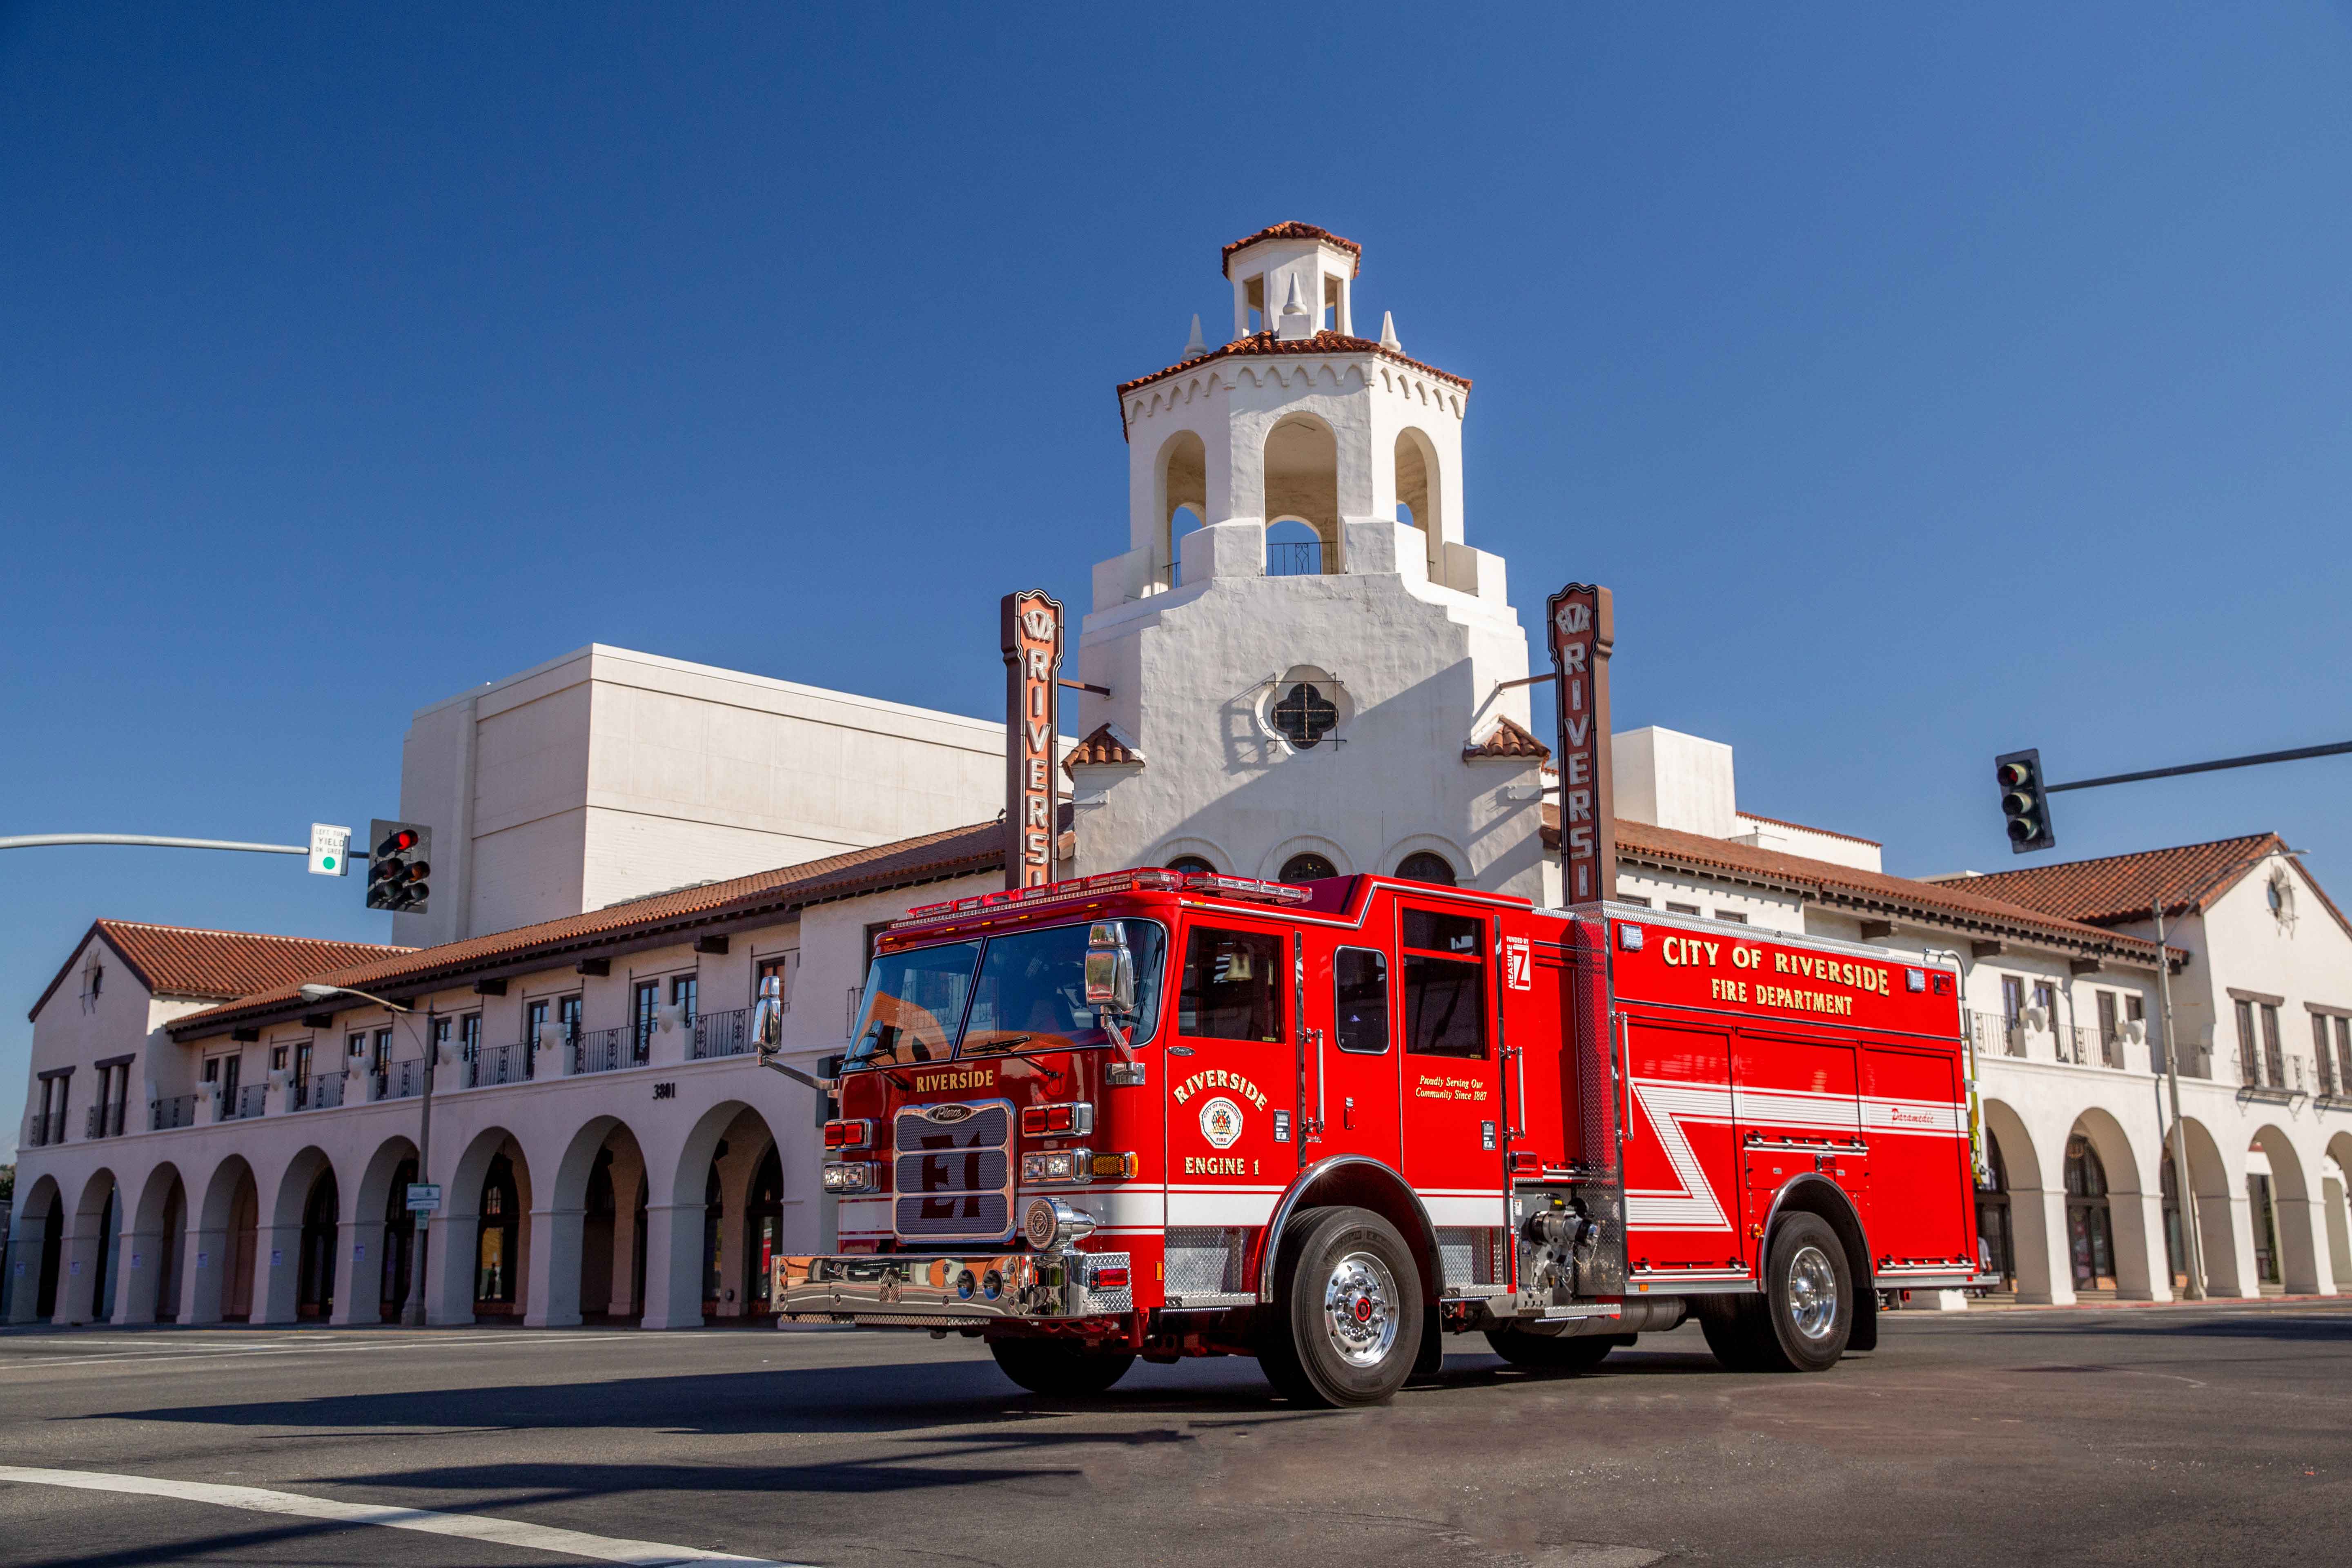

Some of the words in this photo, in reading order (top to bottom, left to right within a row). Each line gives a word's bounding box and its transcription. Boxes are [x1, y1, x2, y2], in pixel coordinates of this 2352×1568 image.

[1022, 609, 1056, 640] FOX
[1555, 603, 1591, 634] FOX
[318, 837, 345, 846] YIELD
[1513, 947, 1530, 989] Z
[1663, 936, 1719, 967] CITY
[1732, 947, 1762, 969] OF
[1774, 952, 1890, 997] RIVERSIDE
[1711, 978, 1748, 1003] FIRE
[1755, 984, 1852, 1016] DEPARTMENT
[653, 1082, 676, 1100] 3801
[916, 1069, 994, 1092] RIVERSIDE
[1173, 1069, 1267, 1111] RIVERSIDE
[1419, 1075, 1444, 1087] Proudly
[1446, 1077, 1469, 1089] Serving
[1471, 1079, 1483, 1089] Our
[1416, 1087, 1452, 1101] Community
[1454, 1089, 1472, 1100] Since
[1473, 1091, 1487, 1101] 1887
[935, 1107, 962, 1120] Pierce
[1203, 1107, 1212, 1118] CITY
[1219, 1103, 1239, 1120] RIVERSIDE
[1891, 1108, 1934, 1125] Paramedic
[920, 1131, 980, 1218] E1
[1185, 1156, 1245, 1175] ENGINE
[1253, 1158, 1259, 1176] 1
